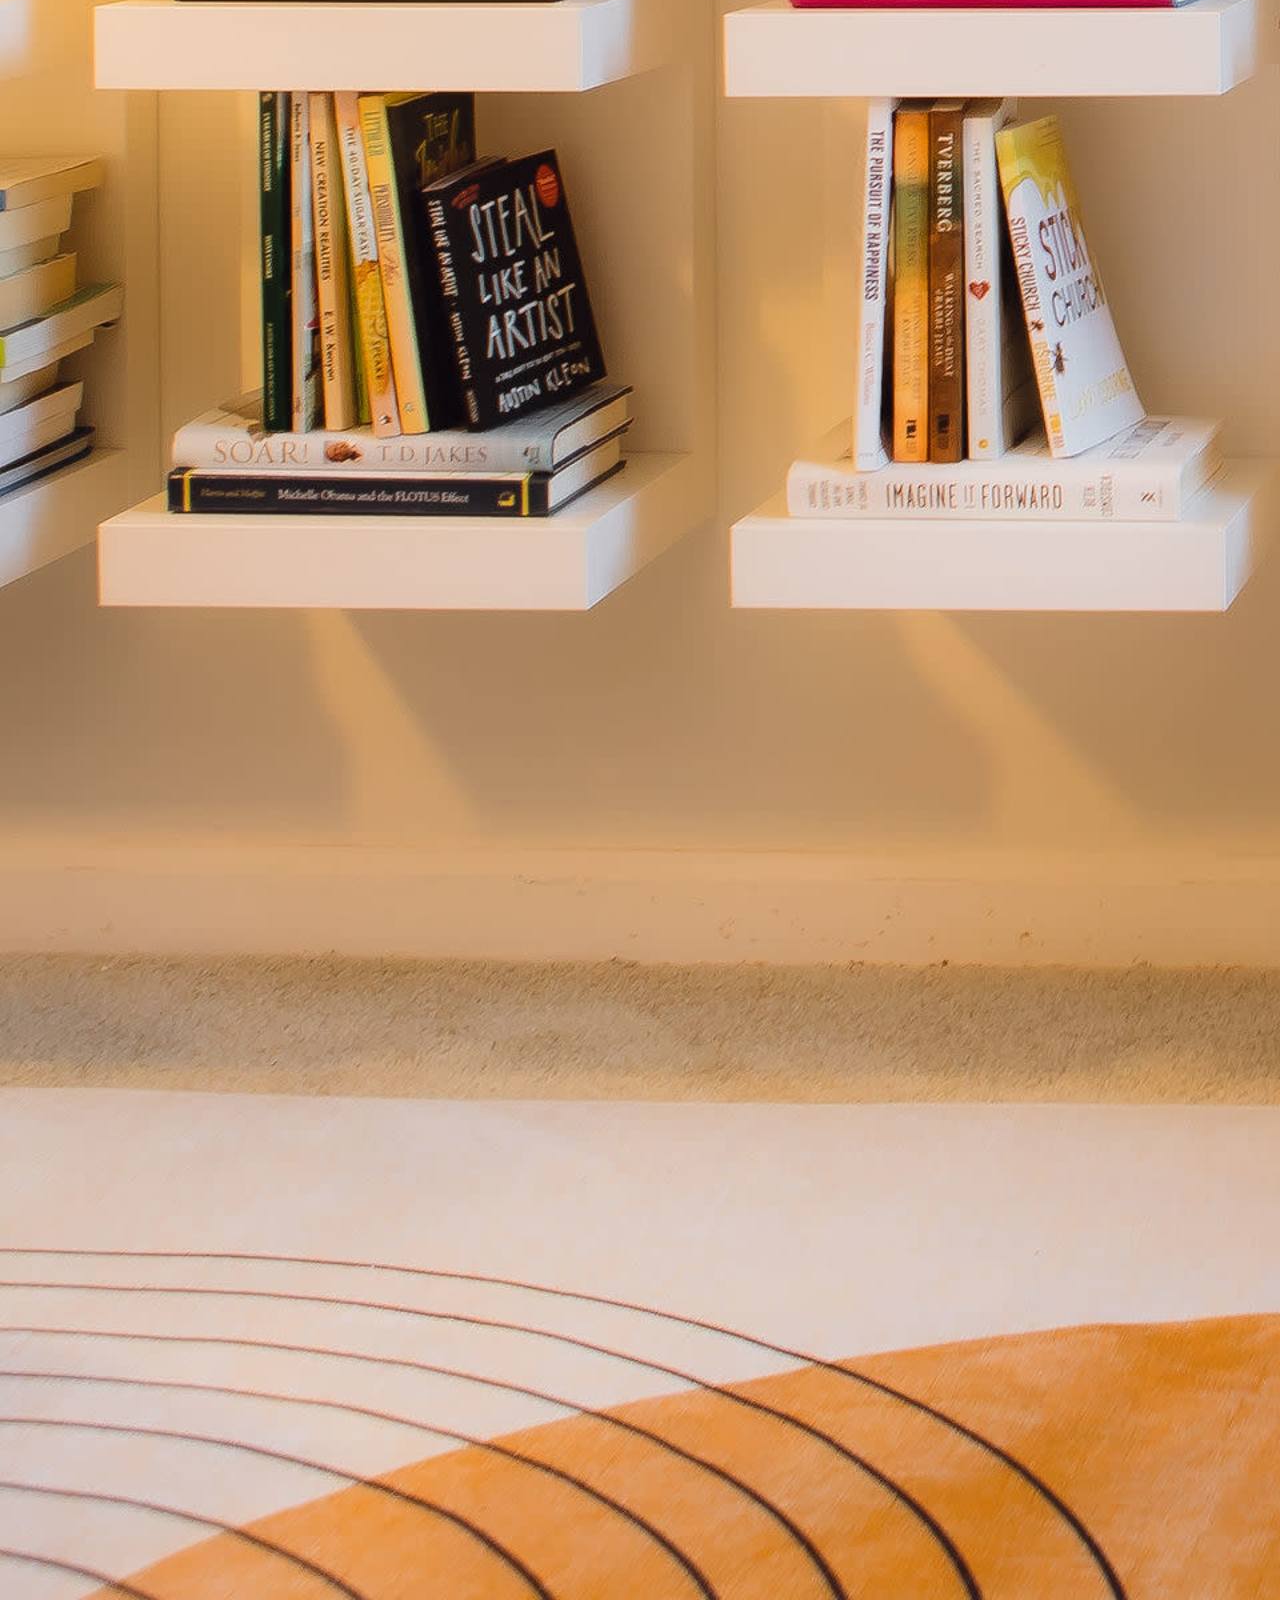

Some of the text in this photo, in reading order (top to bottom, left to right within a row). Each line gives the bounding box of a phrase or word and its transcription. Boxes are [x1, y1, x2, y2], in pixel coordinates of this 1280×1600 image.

[469, 183, 554, 263] STEAL
[864, 131, 885, 302] THE PURSUIT OF HAPPINESS
[478, 247, 560, 304] LIKE AN
[486, 284, 576, 360] ARTIST
[214, 442, 308, 464] SOAR!
